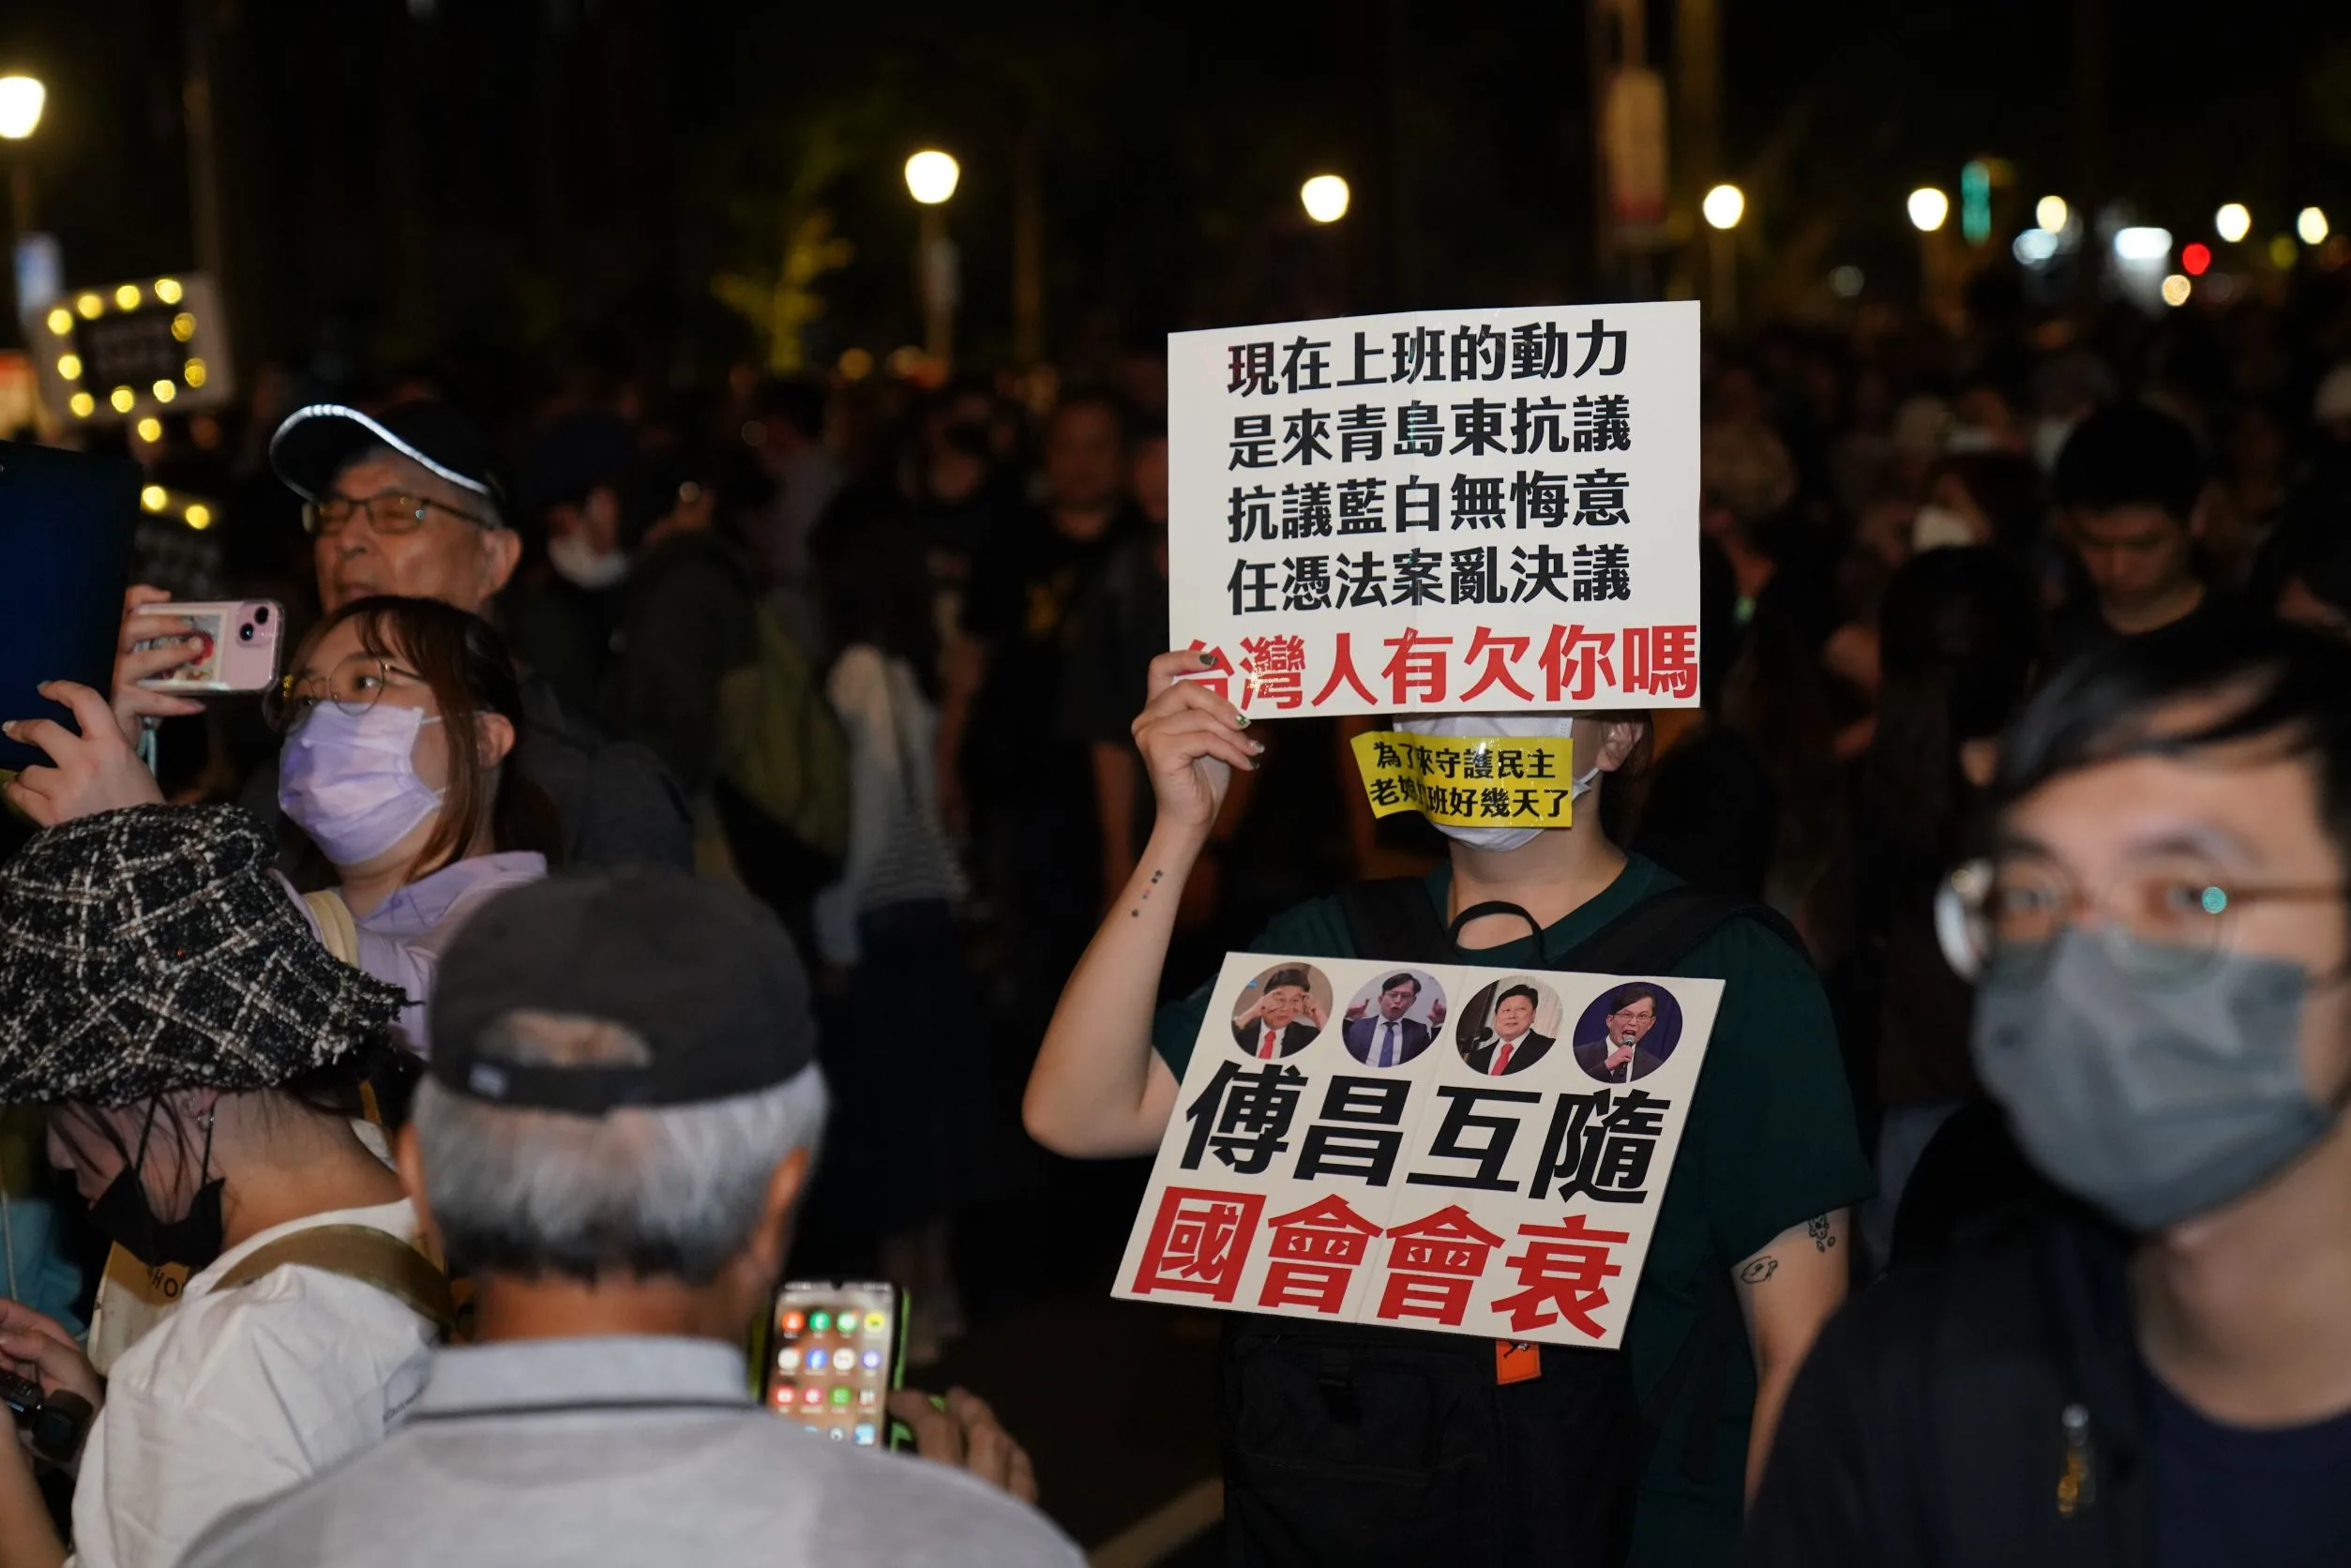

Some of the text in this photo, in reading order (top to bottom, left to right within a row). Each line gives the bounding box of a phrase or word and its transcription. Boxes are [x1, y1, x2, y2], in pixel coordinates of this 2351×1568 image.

[1228, 319, 1629, 398] 現在上班的動力
[1228, 395, 1632, 471] 是來青島東抗議
[1228, 468, 1631, 543] 抗議藍白無悔意
[1227, 543, 1632, 616] 任憑法案亂決議
[1179, 1060, 1671, 1205] 傅昌互隨
[1131, 1186, 1630, 1340] 國會會衰
